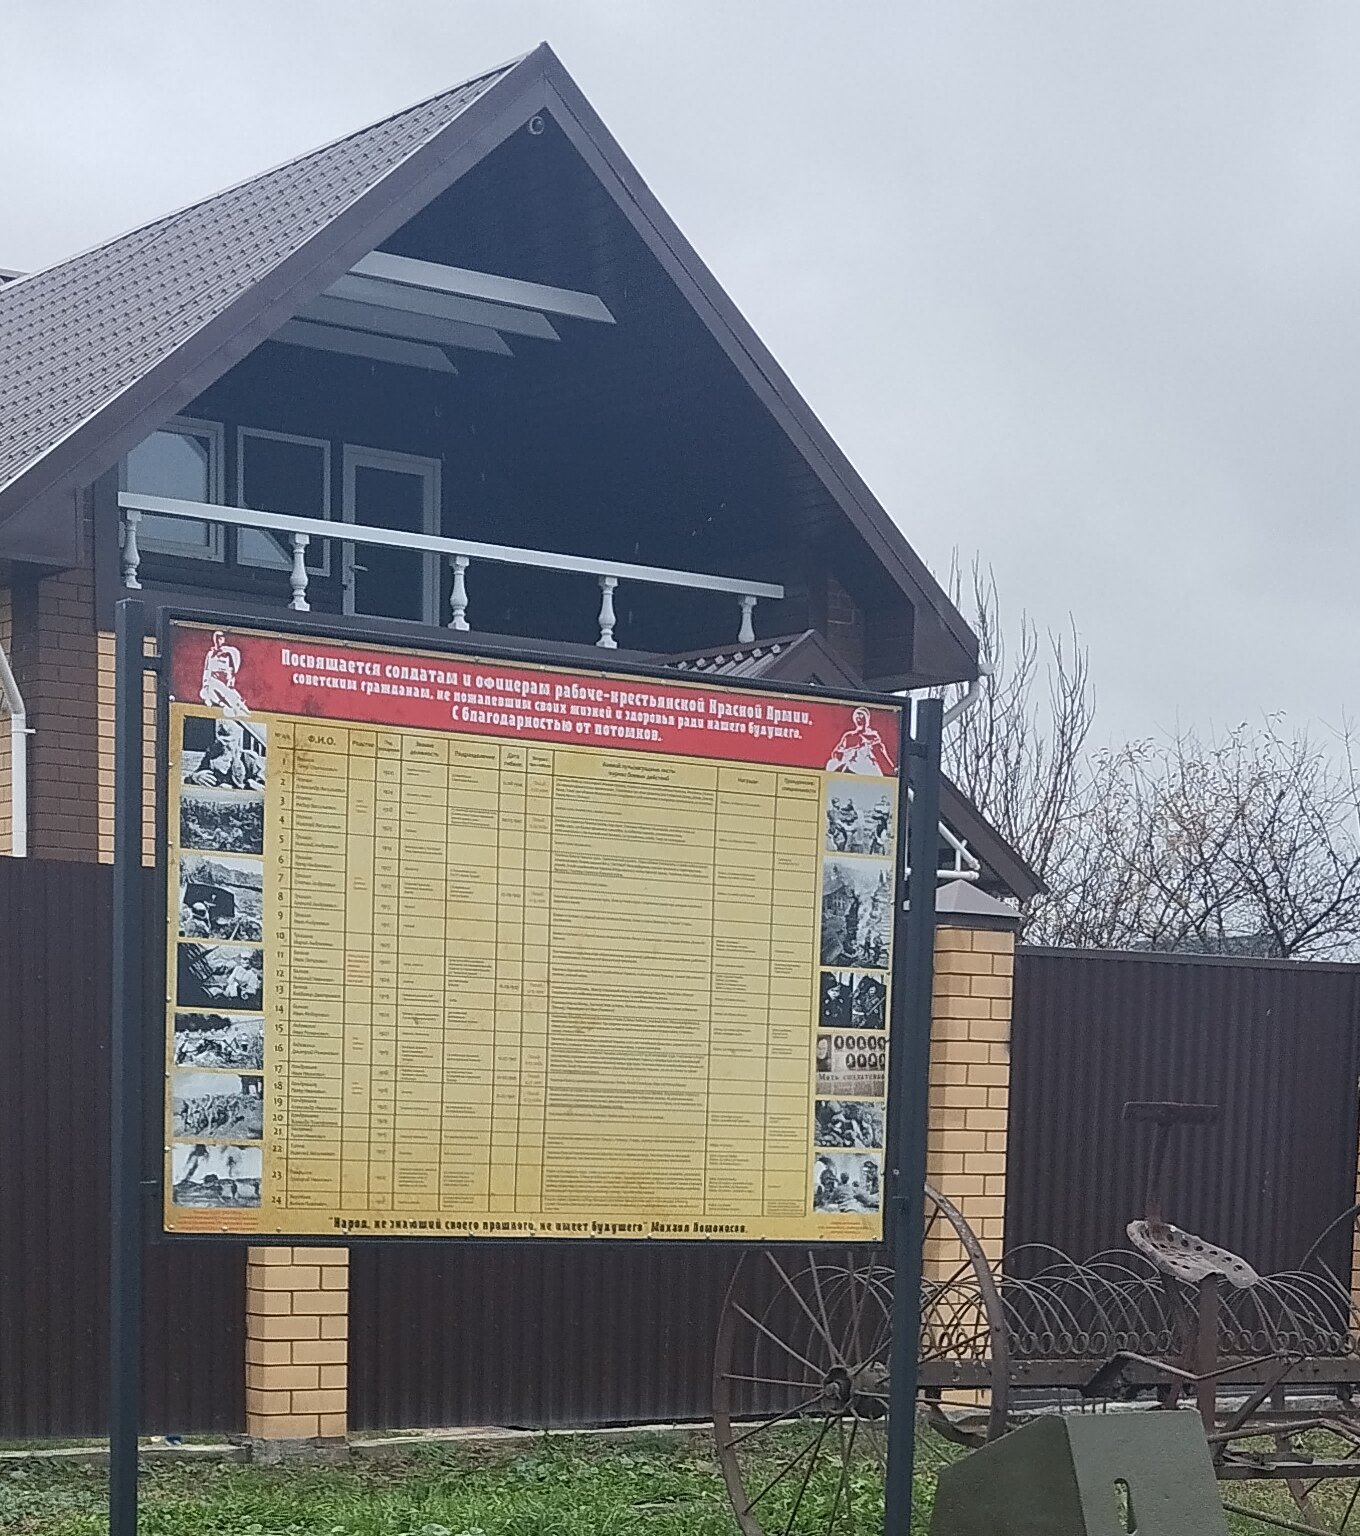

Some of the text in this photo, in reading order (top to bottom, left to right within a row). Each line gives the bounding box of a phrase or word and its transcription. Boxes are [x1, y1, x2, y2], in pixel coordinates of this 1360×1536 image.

[281, 649, 380, 676] Посвящается
[385, 666, 458, 686] солдатам
[462, 673, 472, 687] и
[475, 675, 549, 697] офицерам
[555, 683, 705, 713] рабоче-крестьянской
[709, 699, 762, 719] Красной
[292, 673, 357, 690] советским
[436, 689, 451, 702] не
[453, 691, 531, 711] пожалевшим
[535, 700, 567, 715] своих
[570, 702, 612, 719] жизней
[615, 709, 623, 719] и
[625, 710, 674, 726] здоровья
[678, 716, 704, 730] ради
[707, 718, 746, 734] нашего
[748, 722, 803, 740] будущего.
[452, 705, 663, 742] С благодарностью от потомков.
[308, 735, 337, 746] Ф.И.О.
[276, 951, 284, 959] 11
[275, 985, 284, 994] 13
[275, 1004, 284, 1013] 14
[275, 1024, 283, 1032] 15
[274, 1044, 283, 1052] 16
[274, 1065, 283, 1073] 17
[273, 1082, 283, 1090] 18
[273, 1098, 283, 1107] 19
[273, 1127, 282, 1136] 21
[271, 1171, 282, 1180] 23
[271, 1196, 282, 1205] 24
[374, 1220, 387, 1229] не
[390, 1218, 441, 1231] знающий
[444, 1220, 479, 1231] своего
[540, 1222, 552, 1231] не
[556, 1223, 589, 1232] имеет
[651, 1221, 690, 1233] Михаил
